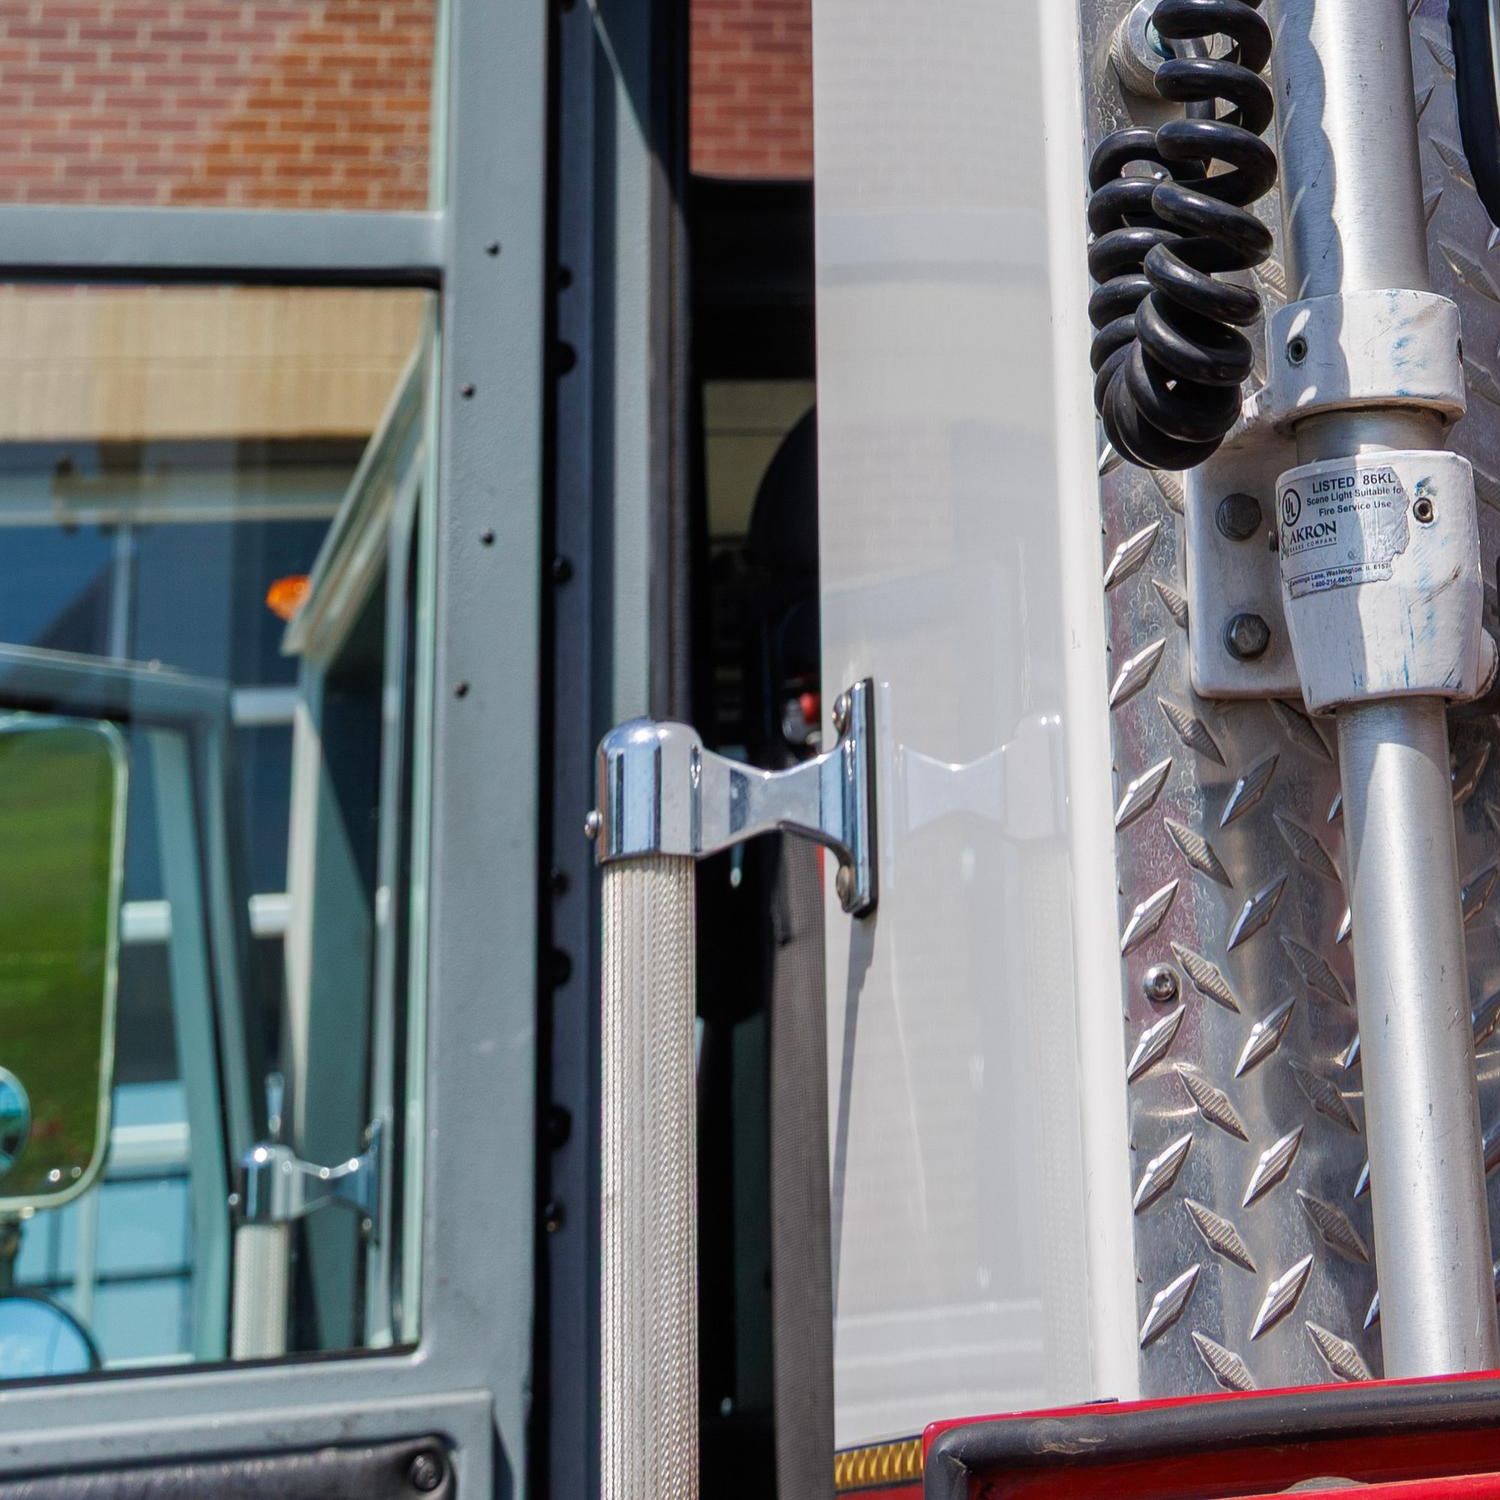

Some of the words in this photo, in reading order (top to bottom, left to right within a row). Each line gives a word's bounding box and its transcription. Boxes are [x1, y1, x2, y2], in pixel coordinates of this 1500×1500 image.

[1312, 476, 1355, 494] LISTED
[1363, 473, 1396, 485] 86KL
[1306, 495, 1329, 506] Scene
[1331, 491, 1353, 502] Light
[1354, 486, 1391, 498] Suitable
[1285, 496, 1296, 519] UL
[1319, 507, 1335, 517] Fire
[1337, 502, 1371, 513] Service
[1374, 501, 1392, 509] Use
[1290, 520, 1337, 545] AKRON
[1307, 537, 1337, 547] COMPANY
